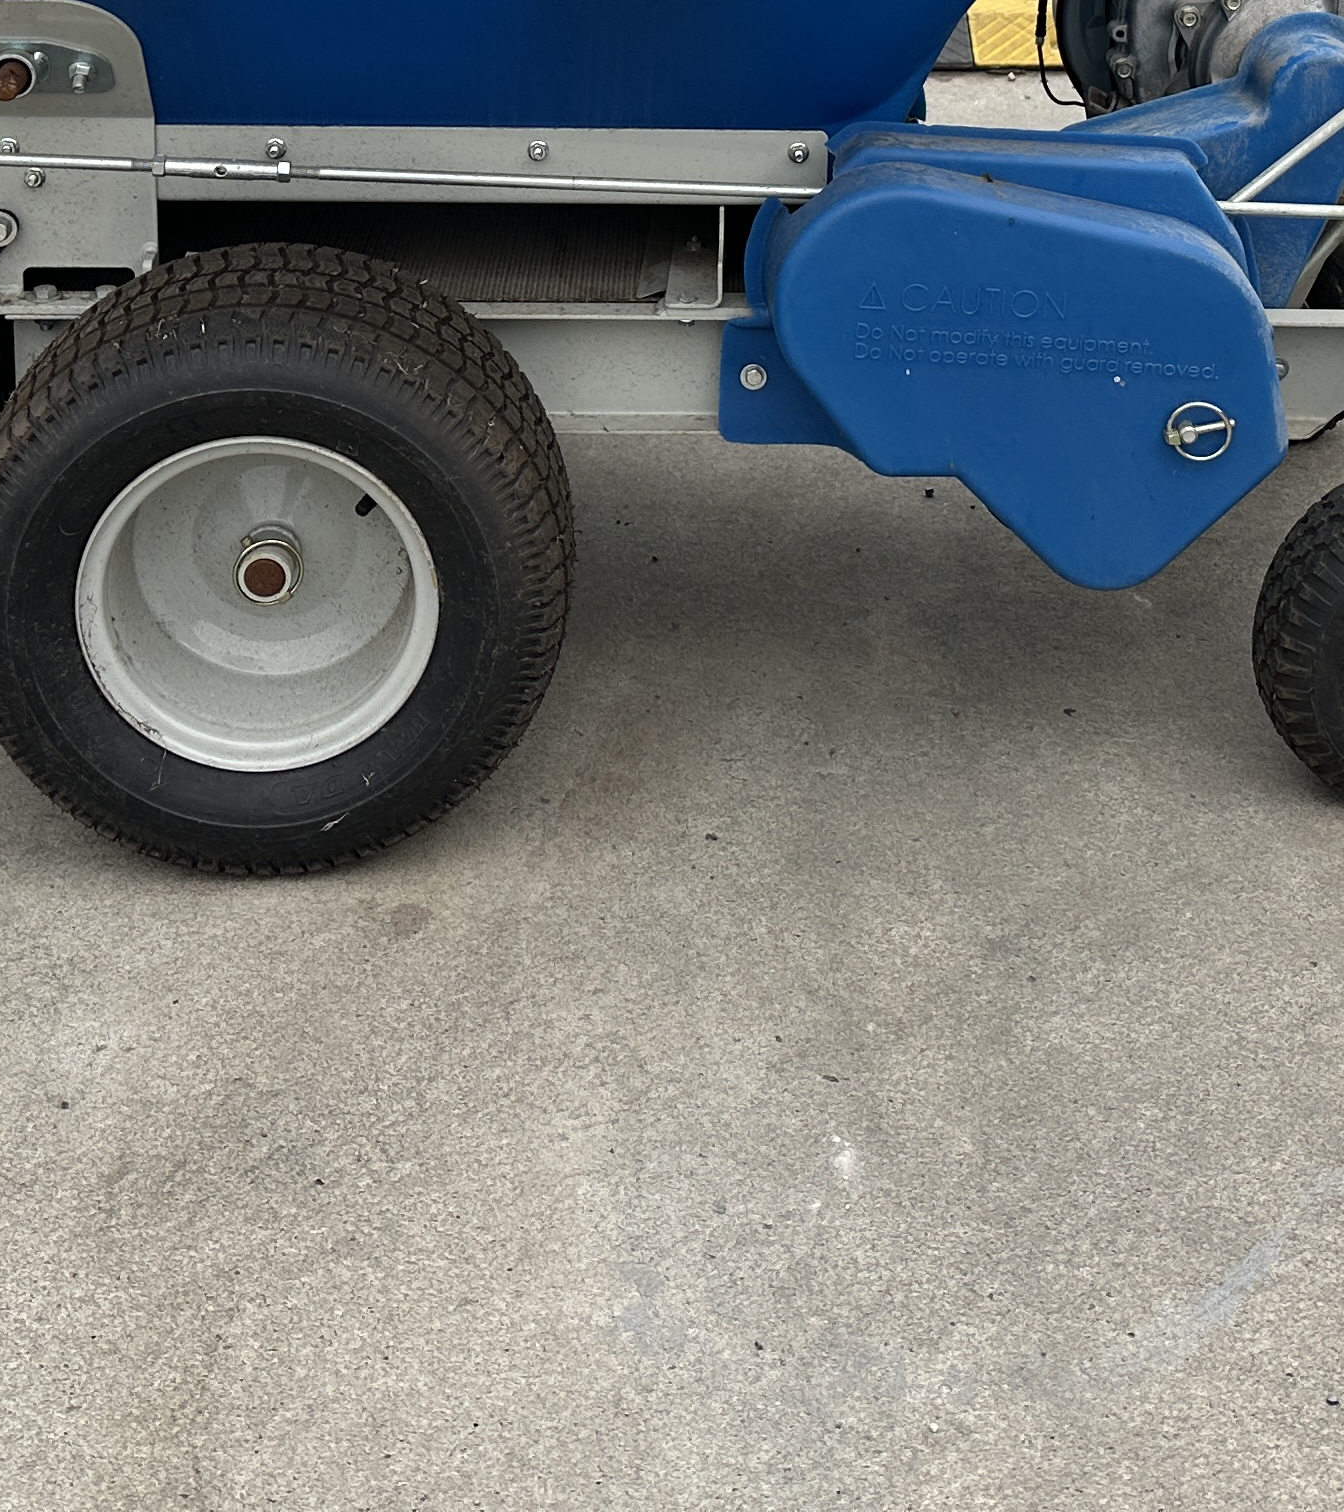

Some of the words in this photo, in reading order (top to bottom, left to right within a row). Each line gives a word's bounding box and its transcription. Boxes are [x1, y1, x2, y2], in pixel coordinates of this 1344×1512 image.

[900, 283, 1068, 319] CAUTION
[855, 322, 884, 340] Do
[891, 324, 926, 342] Not
[930, 326, 1000, 348] modify
[1004, 330, 1035, 348] this
[854, 342, 883, 360] Do
[890, 345, 926, 362] Not
[929, 348, 1008, 369] operate
[1012, 350, 1055, 370] with
[1060, 356, 1121, 376] guard
[1124, 361, 1220, 381] removed.
